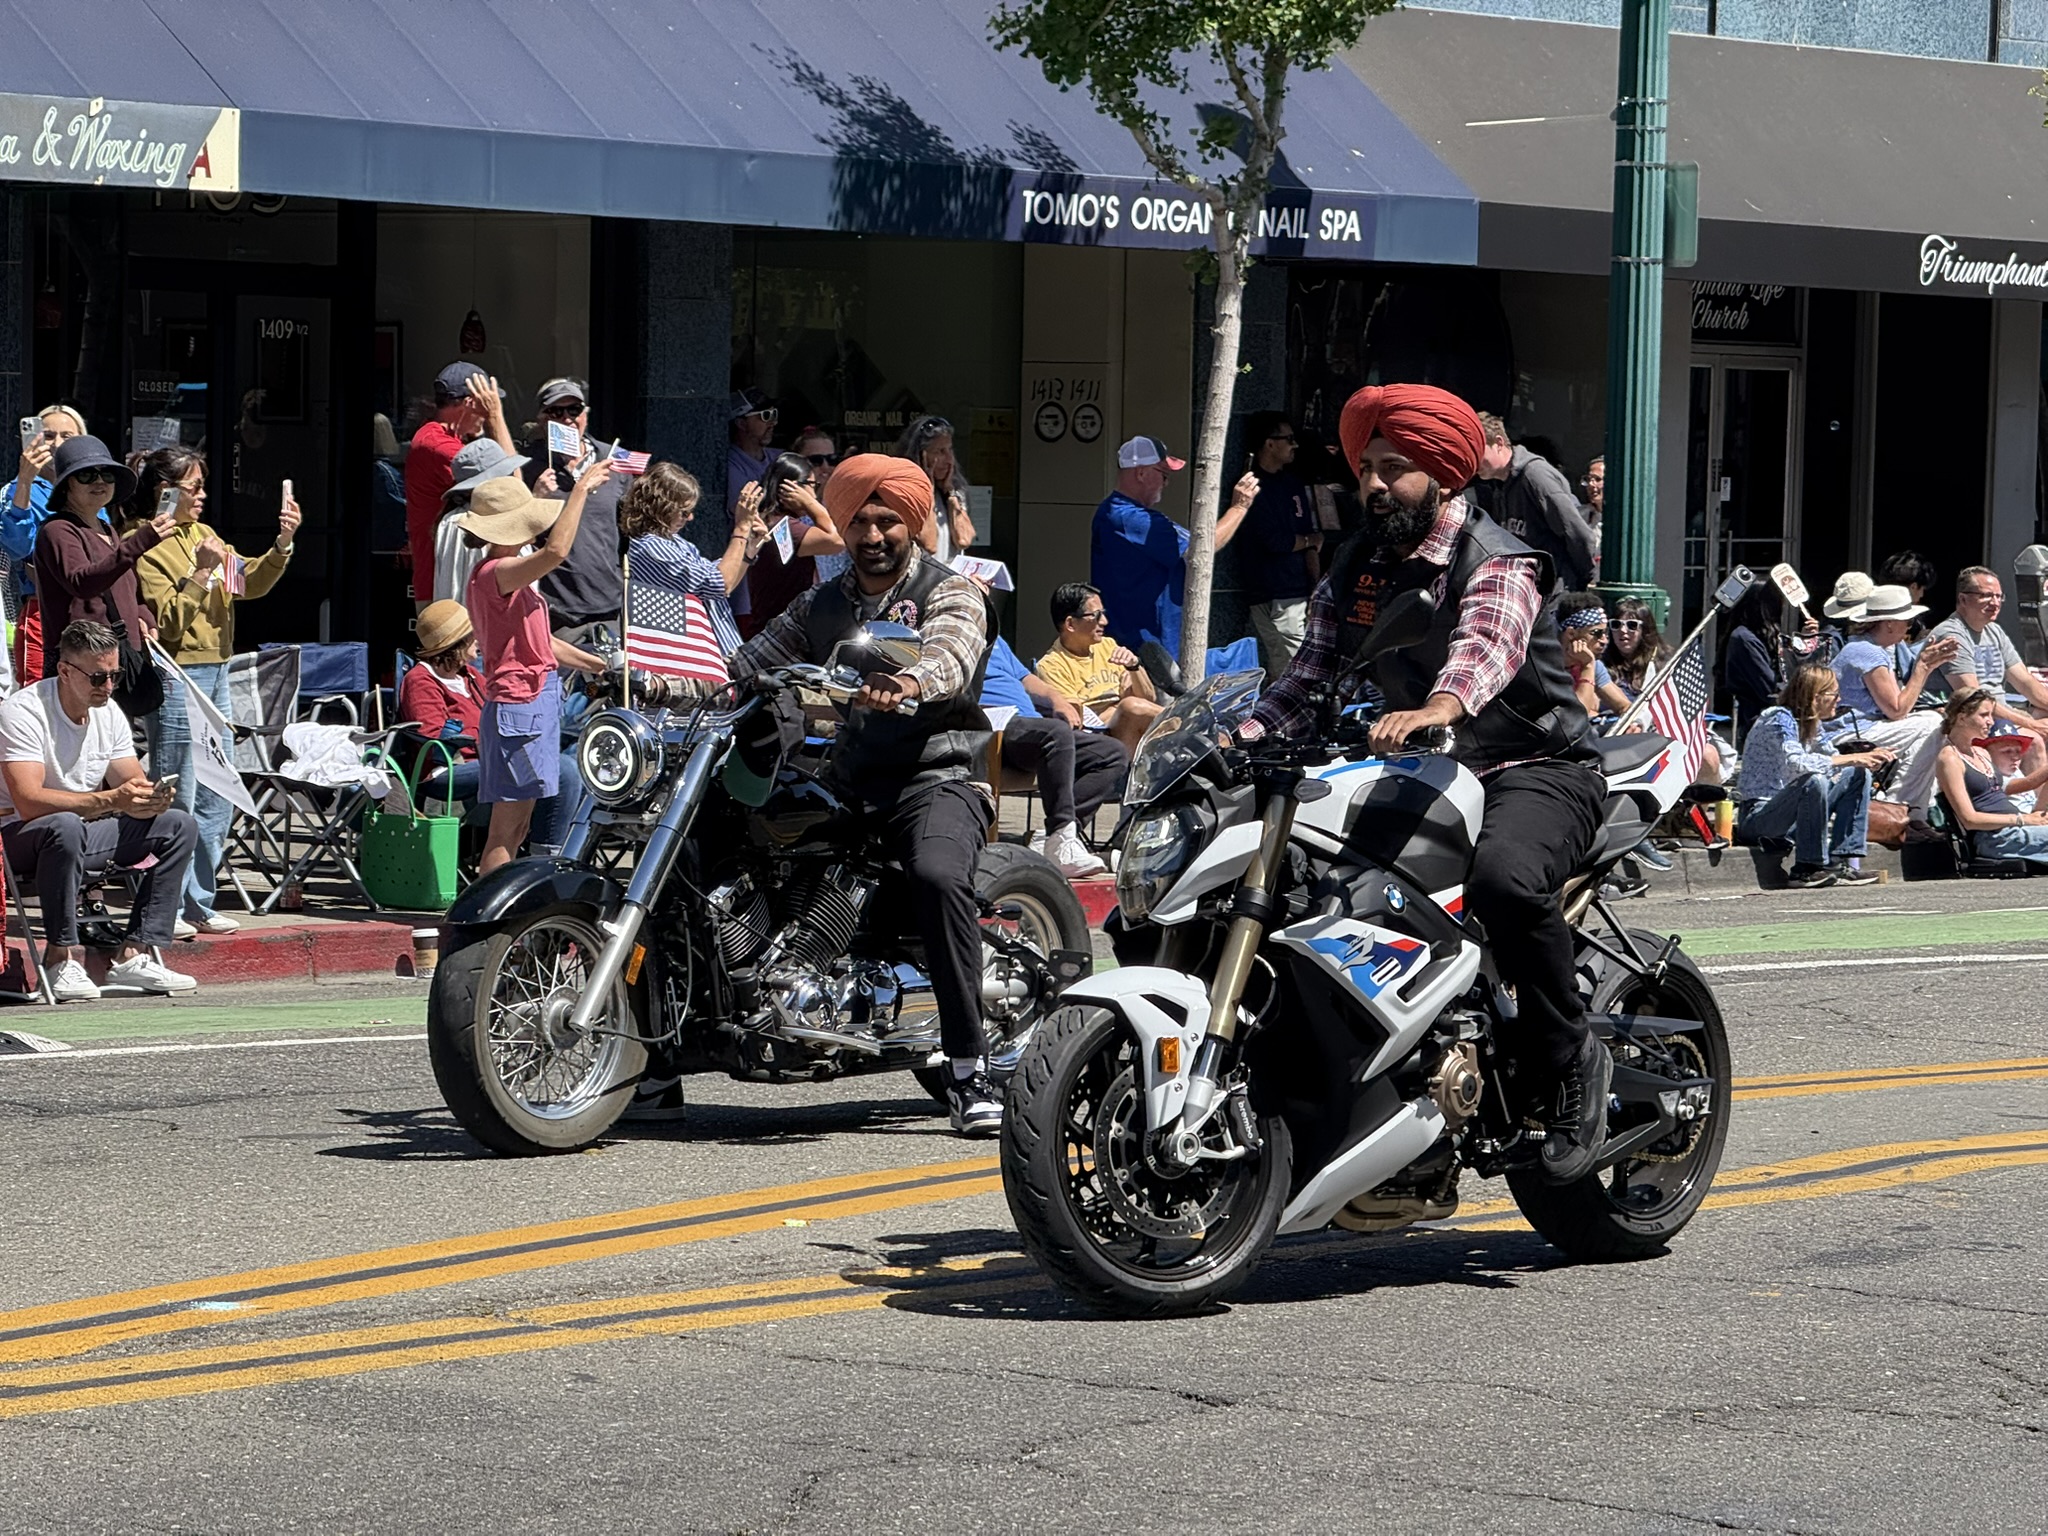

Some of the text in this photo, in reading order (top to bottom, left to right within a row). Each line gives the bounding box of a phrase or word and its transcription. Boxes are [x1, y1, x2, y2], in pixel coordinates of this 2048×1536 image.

[32, 106, 62, 166] &
[67, 113, 187, 188] Waxing
[1022, 190, 1362, 242] TOMO'S ORGAN NAIL SPA
[259, 318, 294, 339] 1409
[1691, 298, 1750, 331] Church
[138, 380, 175, 393] CLOSED
[1031, 377, 1101, 401] 1413 1411
[844, 410, 881, 426] ORGANIC
[885, 411, 904, 426] NAIL
[1238, 1100, 1253, 1139] brembo
